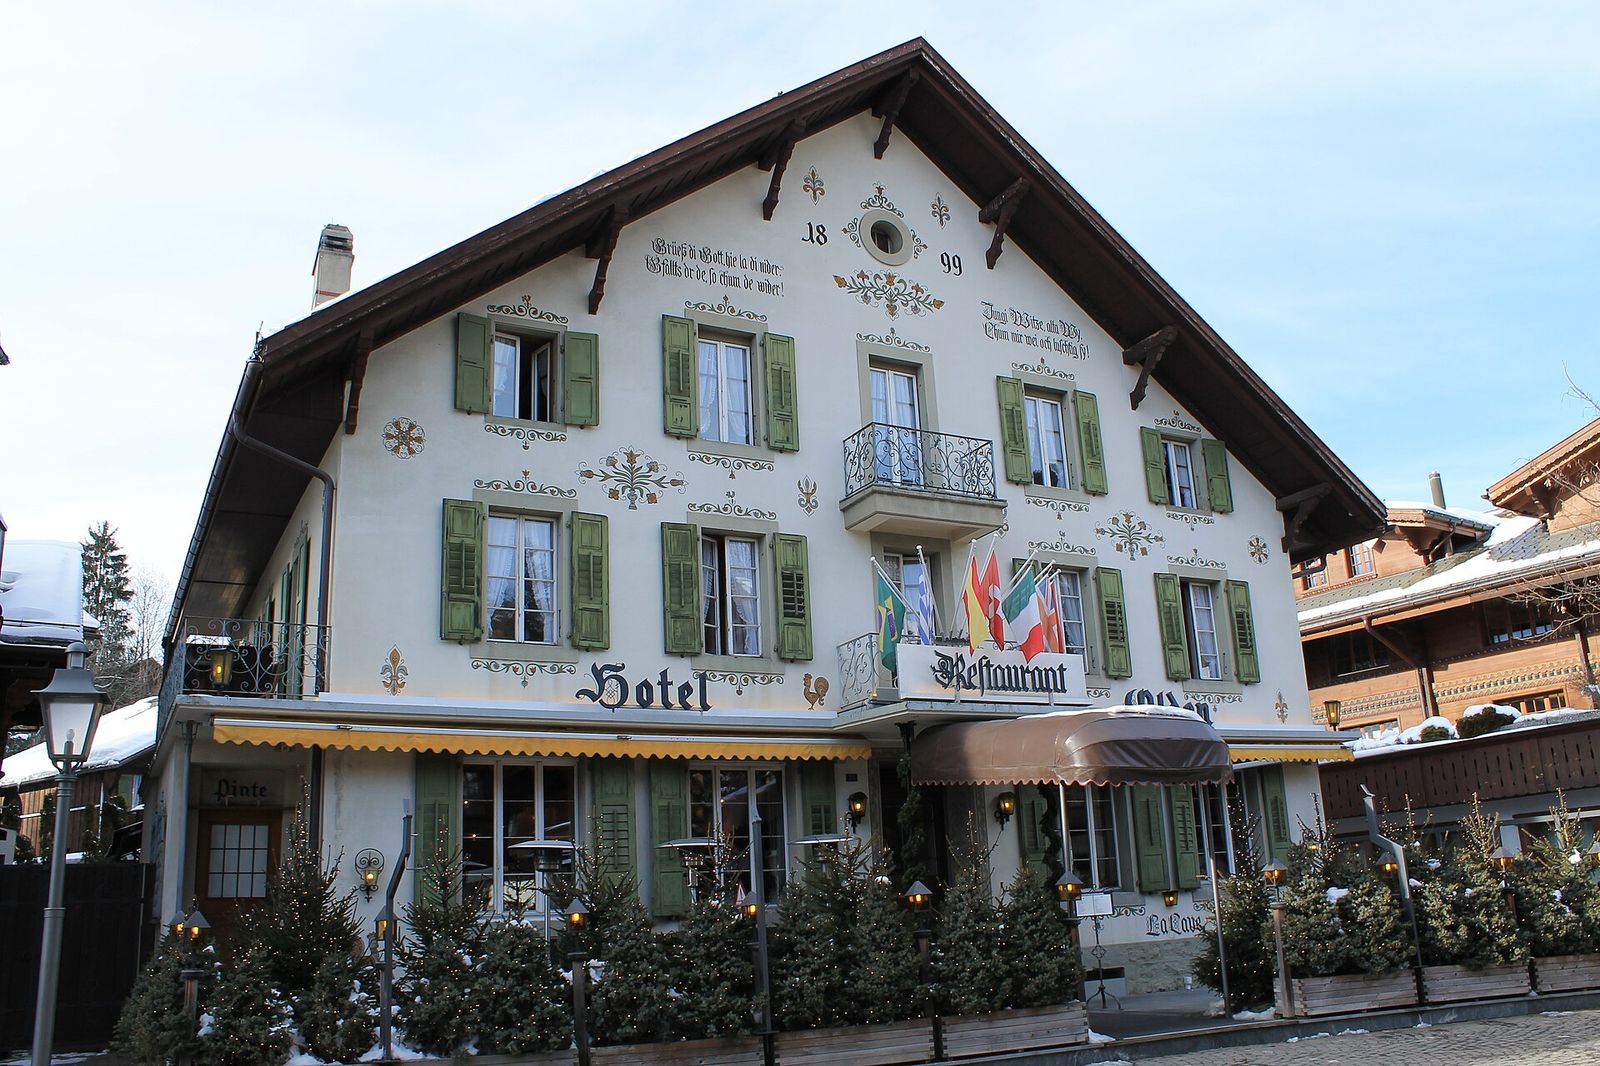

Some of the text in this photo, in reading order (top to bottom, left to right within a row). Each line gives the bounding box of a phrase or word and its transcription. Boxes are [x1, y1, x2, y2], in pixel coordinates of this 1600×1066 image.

[688, 244, 696, 260] di
[739, 255, 748, 270] la
[750, 256, 758, 272] di
[802, 222, 963, 277] 18 99
[684, 263, 694, 279] dr
[743, 275, 754, 290] de
[575, 662, 712, 712] Hotel
[930, 650, 1068, 697] Restaurant
[213, 778, 268, 801] Pinte
[1146, 912, 1202, 936] La Cave
